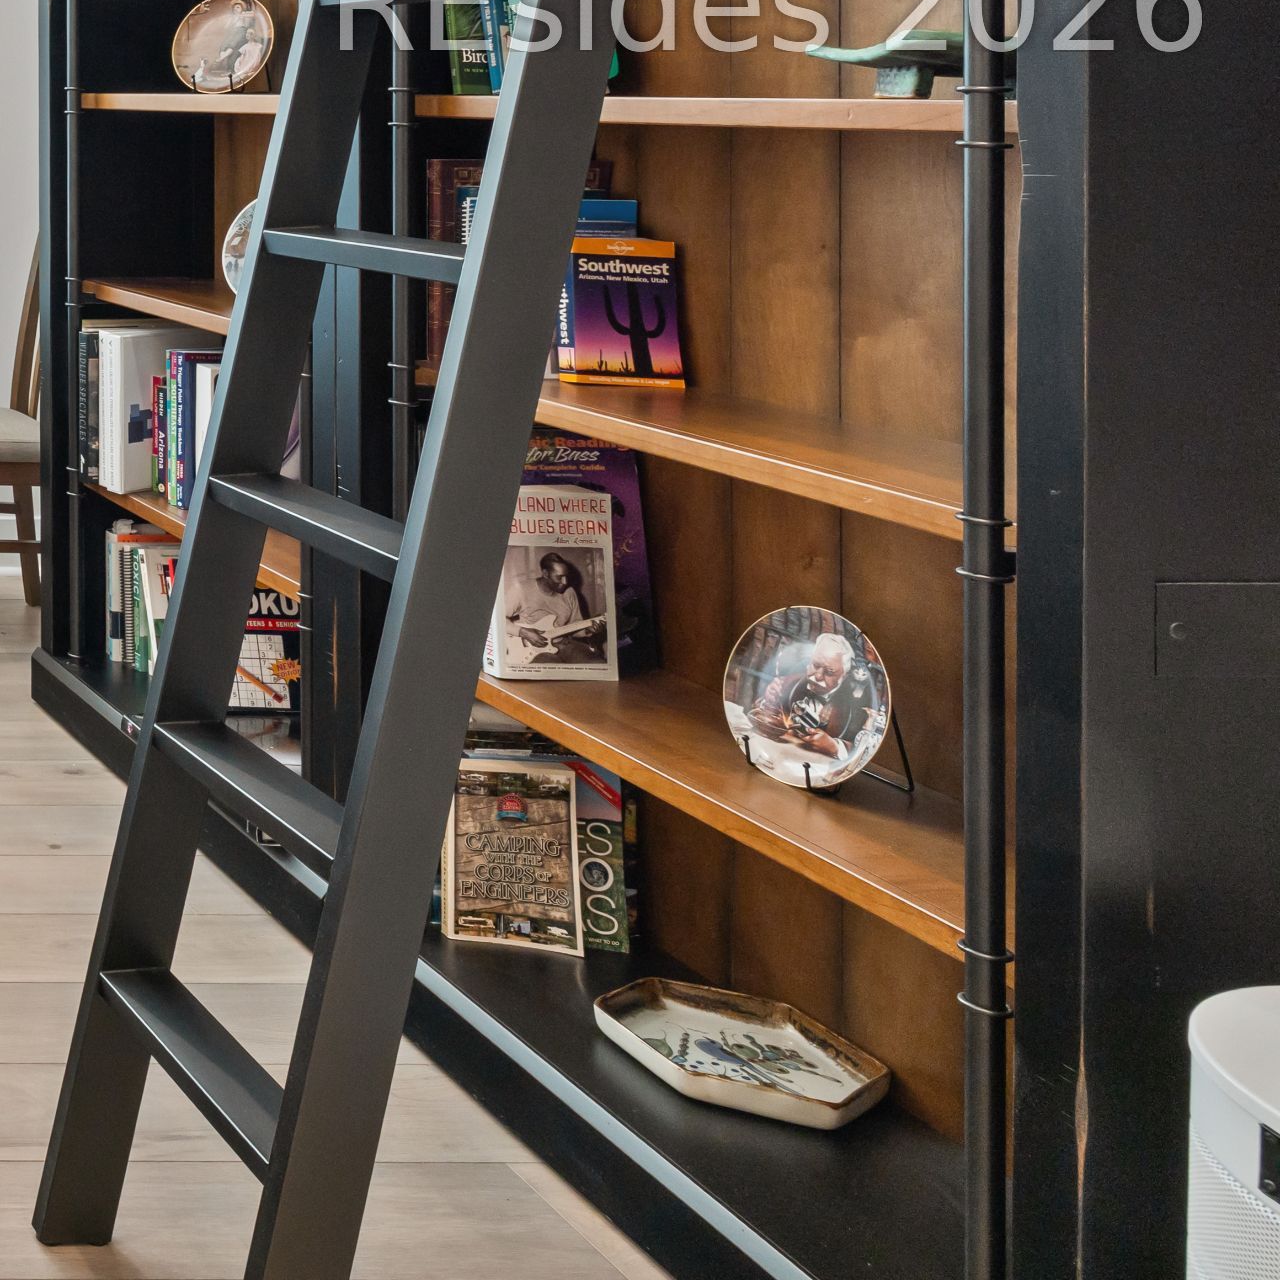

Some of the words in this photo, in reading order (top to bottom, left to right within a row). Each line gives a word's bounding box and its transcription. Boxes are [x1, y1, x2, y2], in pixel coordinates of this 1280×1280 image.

[578, 257, 670, 276] Southwest
[578, 273, 606, 281] Arizona,
[622, 275, 650, 283] Mexico,
[651, 276, 669, 284] Utah
[79, 342, 87, 384] WILDLIFE
[79, 387, 87, 441] SPECTACLES
[158, 431, 166, 469] Arizona
[528, 436, 549, 448] sic
[524, 446, 552, 464] for
[554, 446, 600, 463] Bass
[518, 496, 556, 513] LAND
[559, 498, 607, 514] WHERE
[510, 518, 555, 535] BLUES
[559, 519, 608, 536] BEGAN
[276, 663, 296, 671] NEW
[465, 832, 560, 857] CAMPING
[482, 851, 516, 865] WITH
[517, 853, 543, 867] THE
[474, 862, 535, 884] CORPS
[535, 871, 553, 883] OF
[459, 879, 570, 908] ENGINEERS
